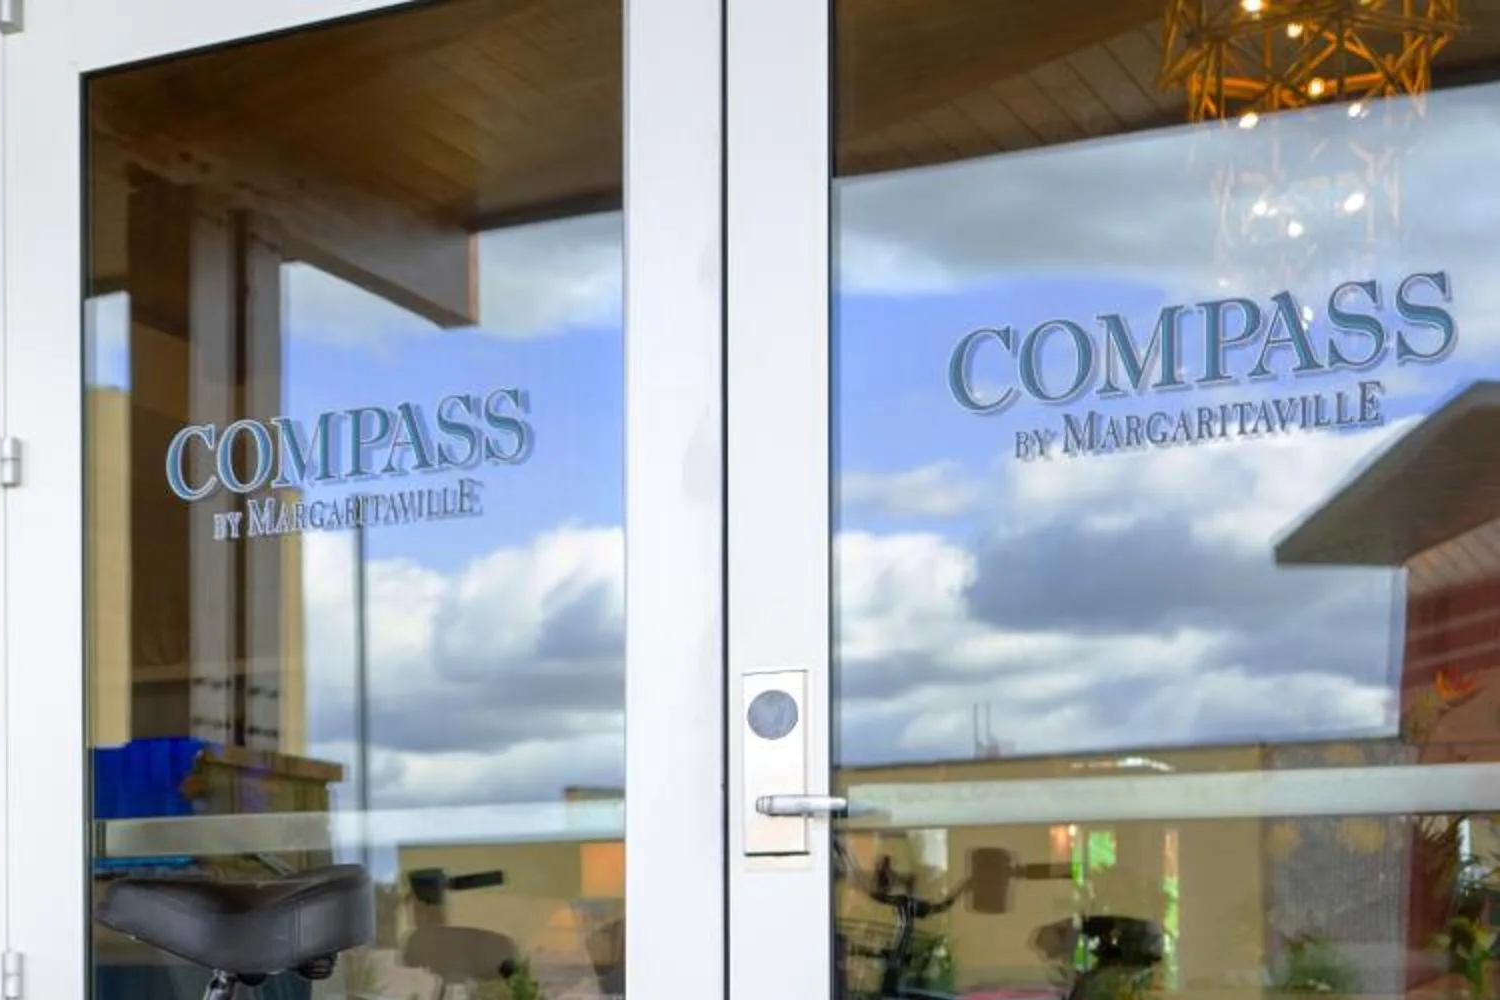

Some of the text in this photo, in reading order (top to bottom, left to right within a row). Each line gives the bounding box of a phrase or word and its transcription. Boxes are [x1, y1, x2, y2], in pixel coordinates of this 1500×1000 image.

[948, 270, 1457, 414] COMPASS
[165, 387, 528, 501] COMPASS
[1014, 379, 1384, 462] BY MARGARITAVILLE
[213, 478, 480, 541] BY MARGARITAVILLE
